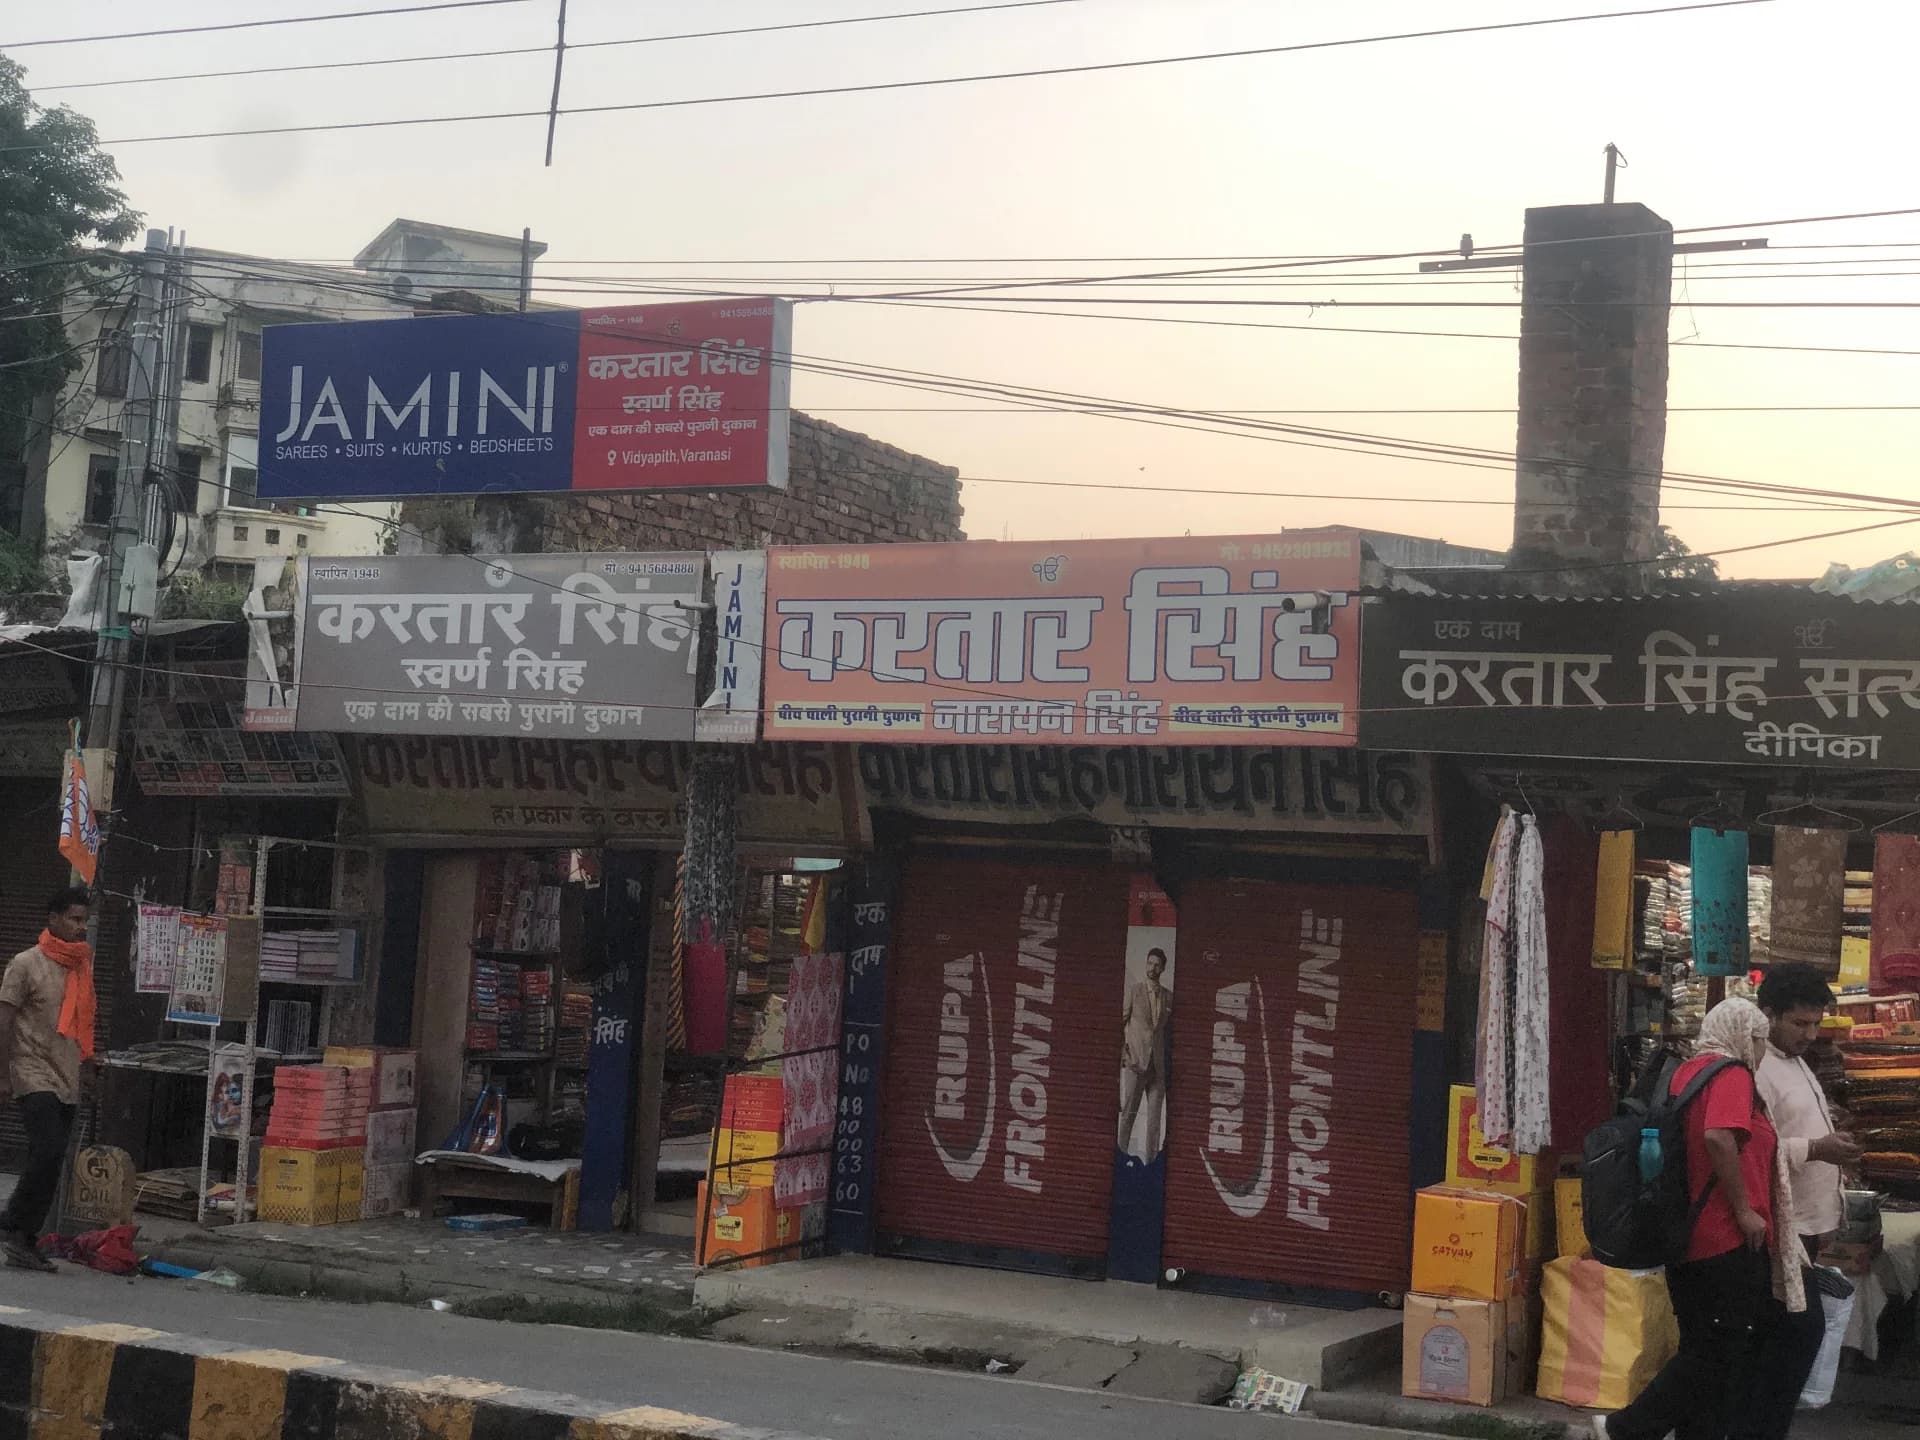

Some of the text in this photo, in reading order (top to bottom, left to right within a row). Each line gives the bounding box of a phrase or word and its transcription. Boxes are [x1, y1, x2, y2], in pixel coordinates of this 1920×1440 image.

[588, 338, 765, 380] करतार सिंह
[276, 365, 555, 442] JAMINI
[622, 384, 725, 414] स्वर्ण सिंह
[588, 418, 757, 437] एक दाम की सबसे पुरानी दुकान
[276, 436, 554, 460] SAREES SUITS KURTIS BEDSHEETS
[312, 566, 380, 579] स्थापित 1948
[312, 573, 698, 651] करतार सिंह
[776, 567, 1348, 682] करतार सिंह
[1434, 621, 1521, 640] एक दाम
[724, 564, 743, 715] JAMINI
[401, 648, 587, 694] स्वर्ण सिंह
[1400, 650, 1612, 710] करतार
[1638, 630, 1778, 721] सिंह
[344, 695, 643, 732] एक दाम की सबसे पुरानी दुकान
[1085, 690, 1163, 735] सिंह
[1743, 721, 1882, 760] दीपिका
[853, 902, 886, 926] एक
[850, 945, 886, 976] दाम
[593, 1014, 629, 1045] सिंह
[934, 952, 975, 1120] RUPA
[1004, 884, 1064, 1194] FRONTLINE
[1209, 981, 1251, 1154] RUPA
[1286, 908, 1344, 1231] FRONTLINE
[840, 1096, 863, 1116] 48
[1431, 1245, 1473, 1259] SATYAM
